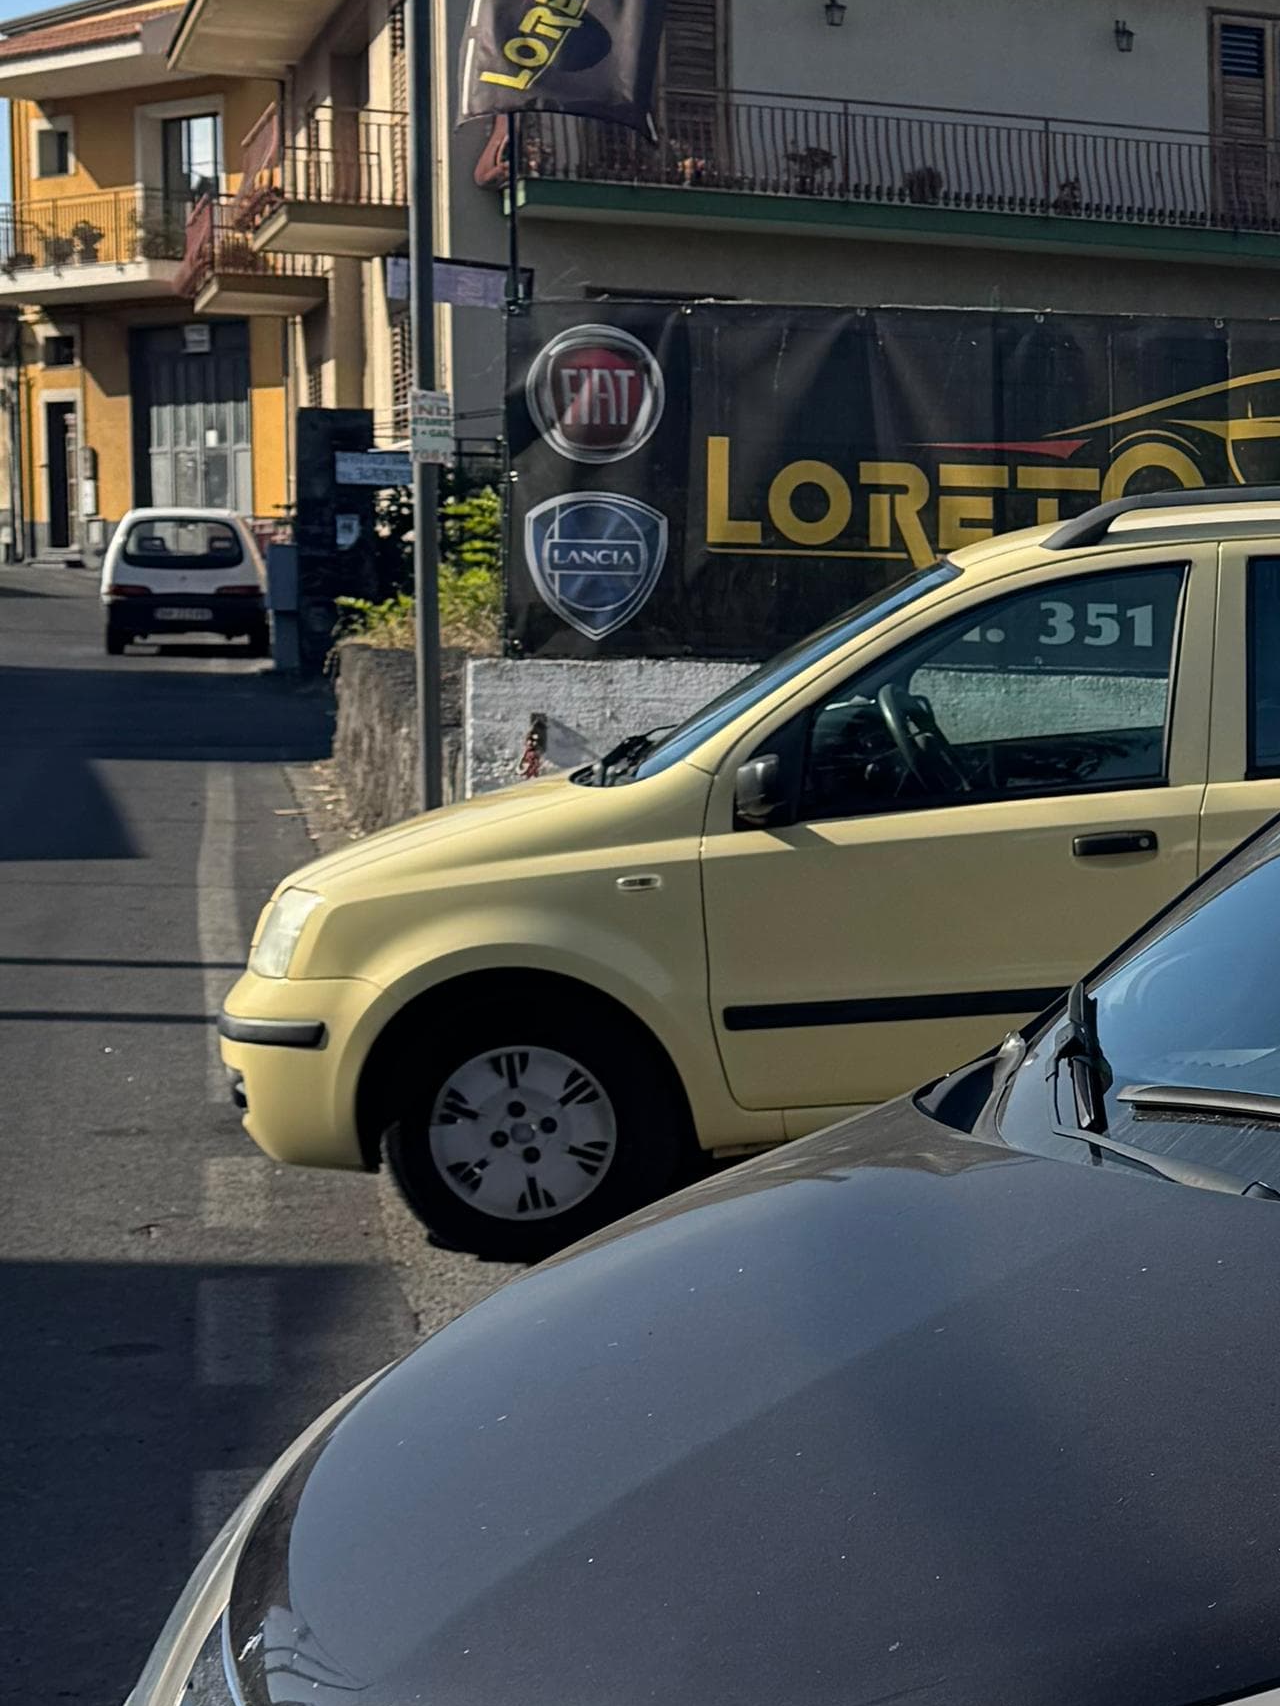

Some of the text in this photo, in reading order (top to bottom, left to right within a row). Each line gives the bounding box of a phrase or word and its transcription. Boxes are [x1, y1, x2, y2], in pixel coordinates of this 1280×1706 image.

[560, 368, 636, 425] FIAT
[553, 548, 635, 565] LANCIA
[1038, 601, 1154, 647] 351
